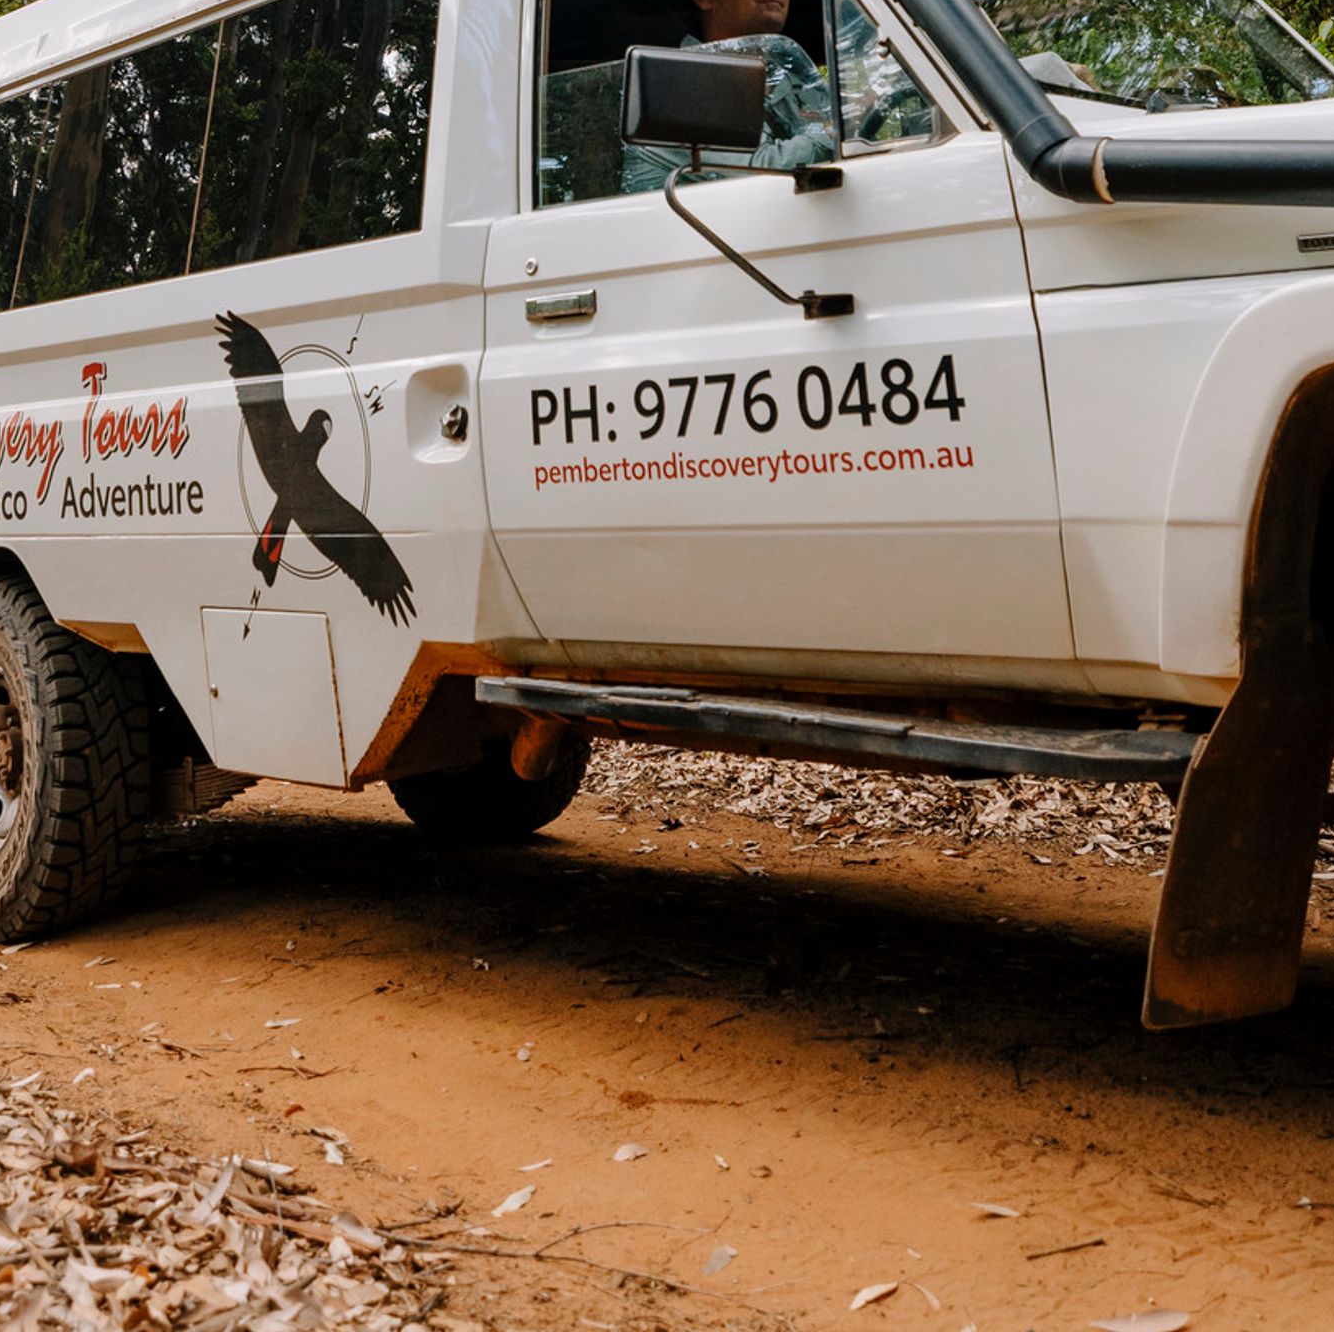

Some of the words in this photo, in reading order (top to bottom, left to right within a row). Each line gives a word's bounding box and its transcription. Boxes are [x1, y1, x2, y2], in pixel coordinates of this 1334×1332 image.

[81, 361, 190, 464] Tours
[530, 384, 618, 447] PH:
[633, 369, 779, 440] 9776
[796, 354, 966, 431] 0484
[61, 472, 205, 519] Adventure
[533, 445, 975, 492] pembertondiscoverytours.com.au
